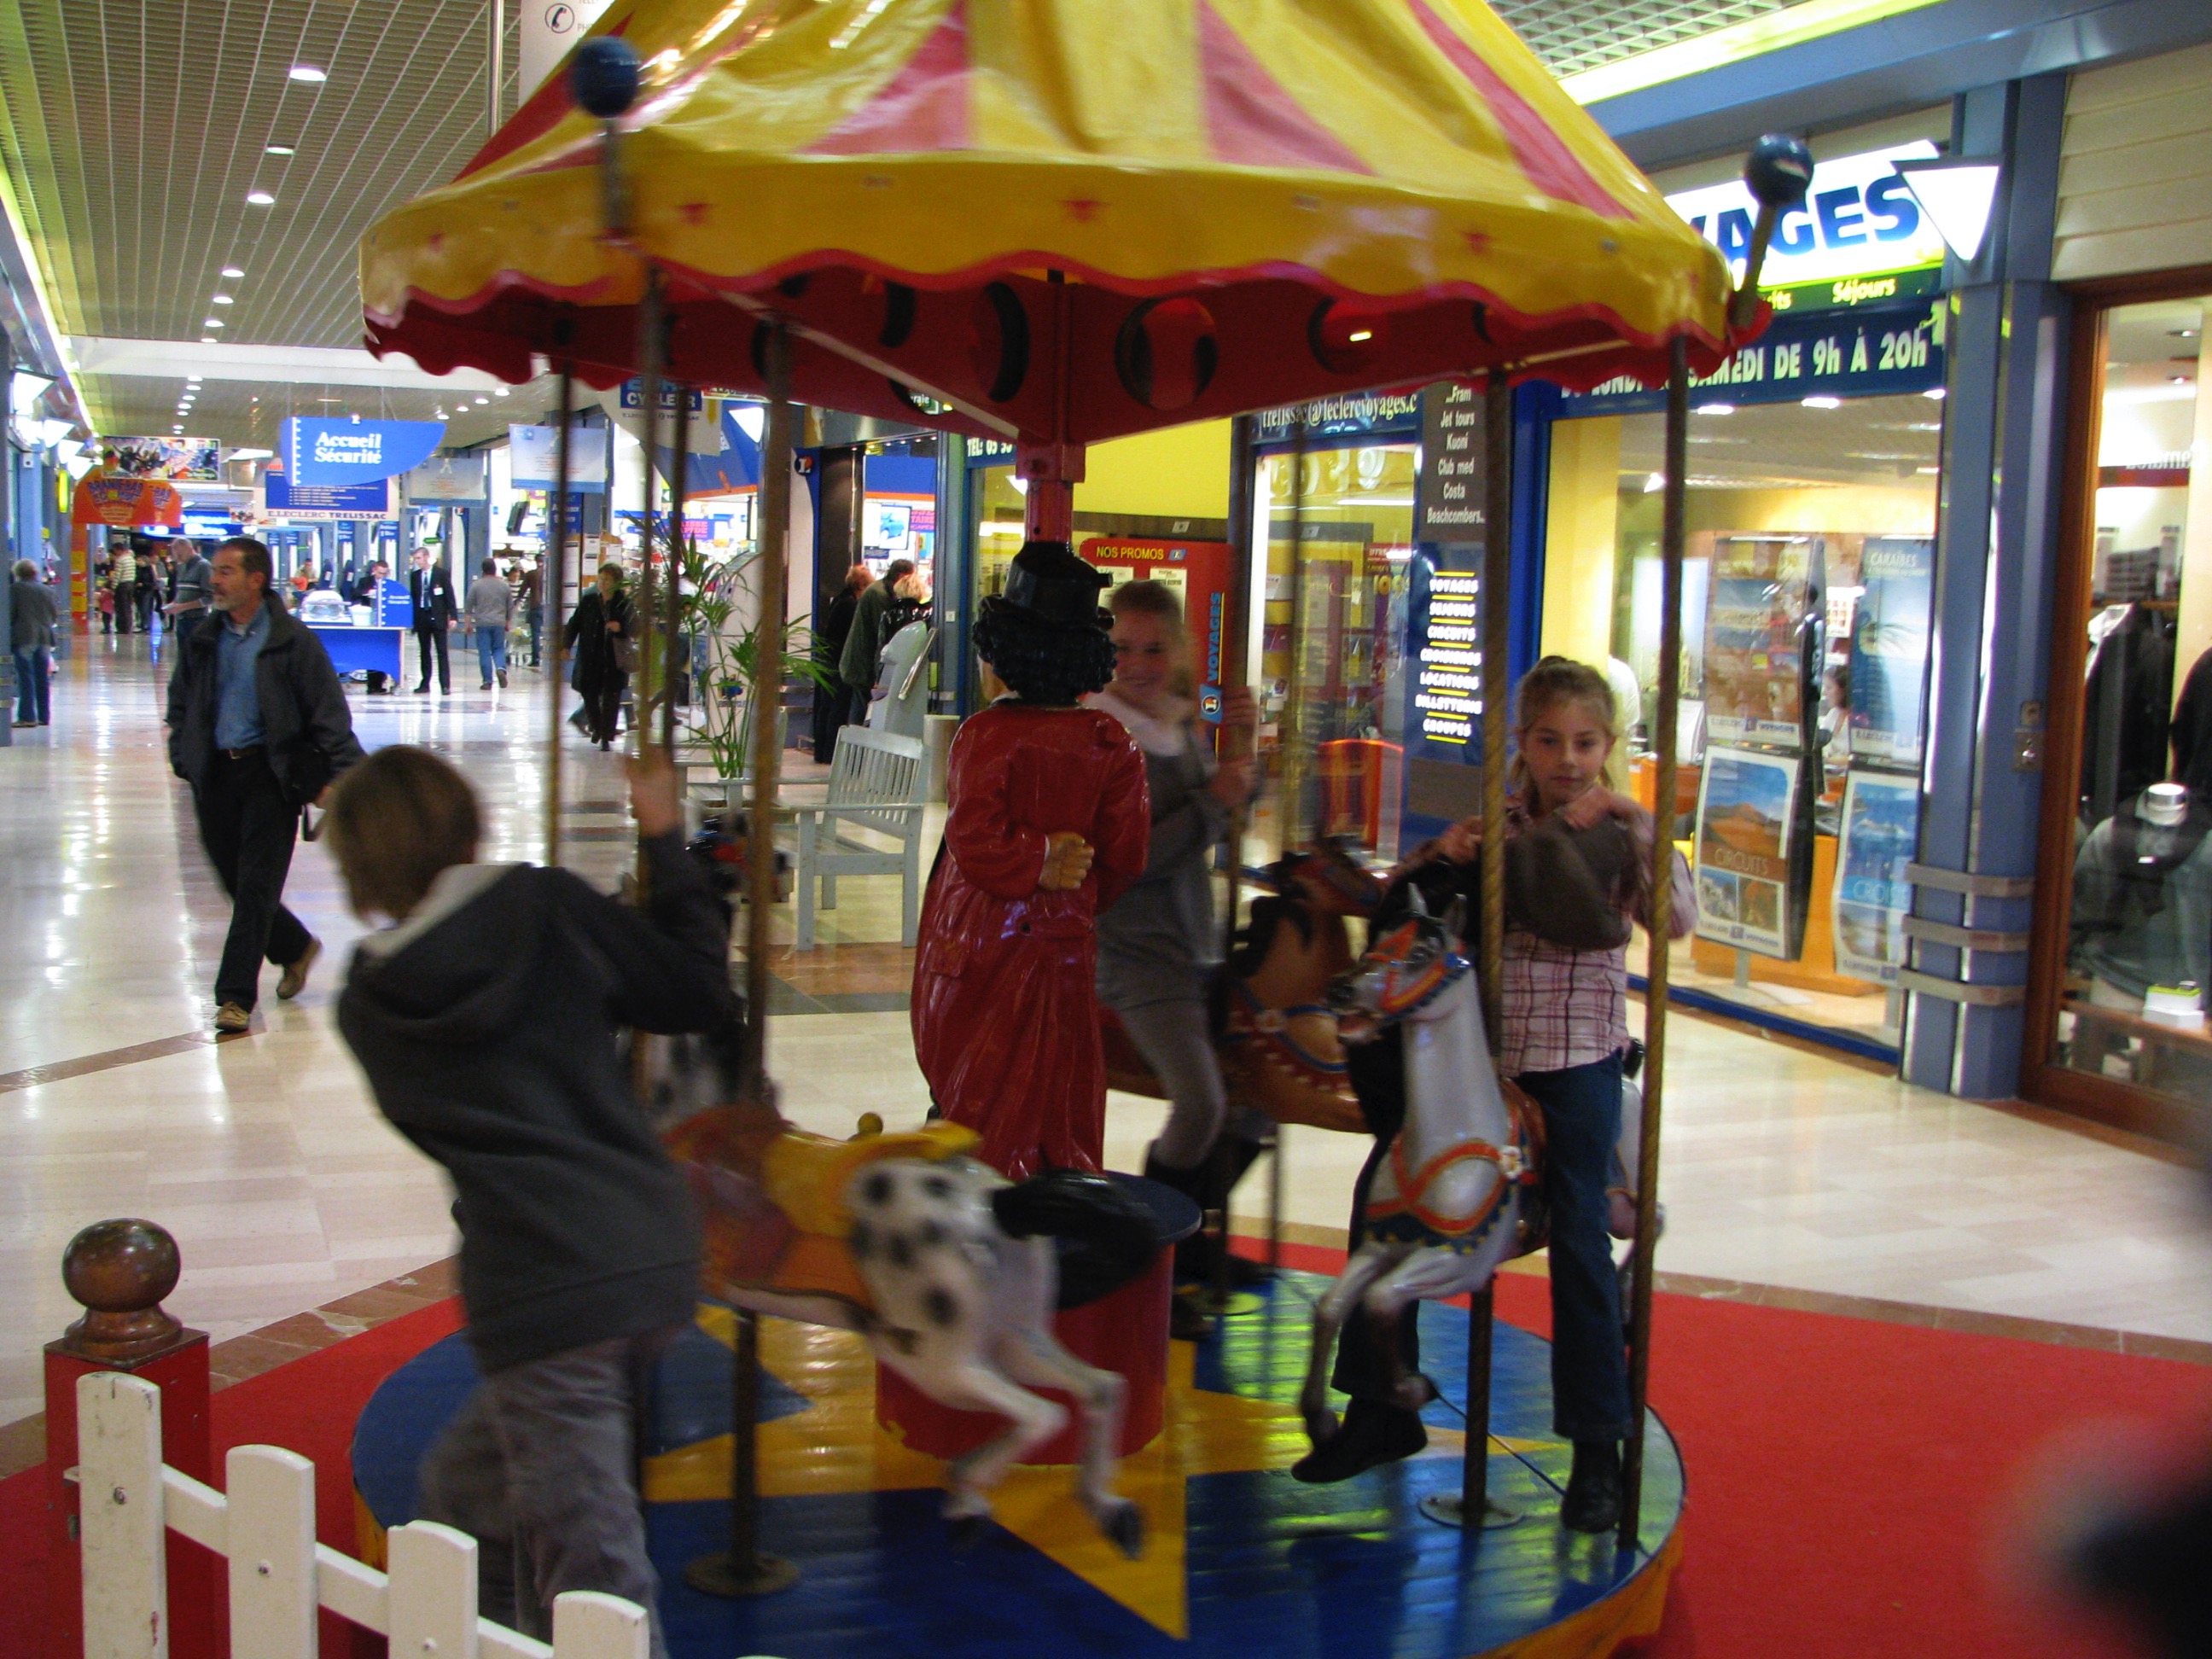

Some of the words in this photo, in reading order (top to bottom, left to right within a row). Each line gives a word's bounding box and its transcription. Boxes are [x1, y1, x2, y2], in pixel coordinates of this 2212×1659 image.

[1689, 175, 1919, 273] AGES
[1832, 277, 1896, 306] Séjours
[1774, 343, 1802, 381] DE
[1813, 336, 1841, 375] 9h
[1850, 326, 1867, 372] À
[1879, 329, 1927, 370] 20h
[626, 392, 696, 408] CYLER
[1441, 410, 1453, 428] Jet
[1455, 410, 1475, 428] tours
[315, 432, 381, 449] Accueil
[1446, 432, 1469, 451] Kuoni
[314, 447, 382, 464] Sécurité
[1438, 457, 1455, 476] Club
[1457, 457, 1474, 475] med
[1443, 481, 1466, 500] Costa
[1097, 545, 1119, 559] NOS
[1121, 547, 1165, 561] PROMOS
[1429, 579, 1479, 594] VOYAGES
[1208, 592, 1221, 681] VOYAGES
[1427, 625, 1476, 642] CIRCUITS
[1419, 672, 1480, 690] LOCATIONS
[1414, 694, 1483, 715] BILLETTERIE
[1422, 719, 1472, 737] GROUPES
[1714, 847, 1769, 876] CIRCUITS
